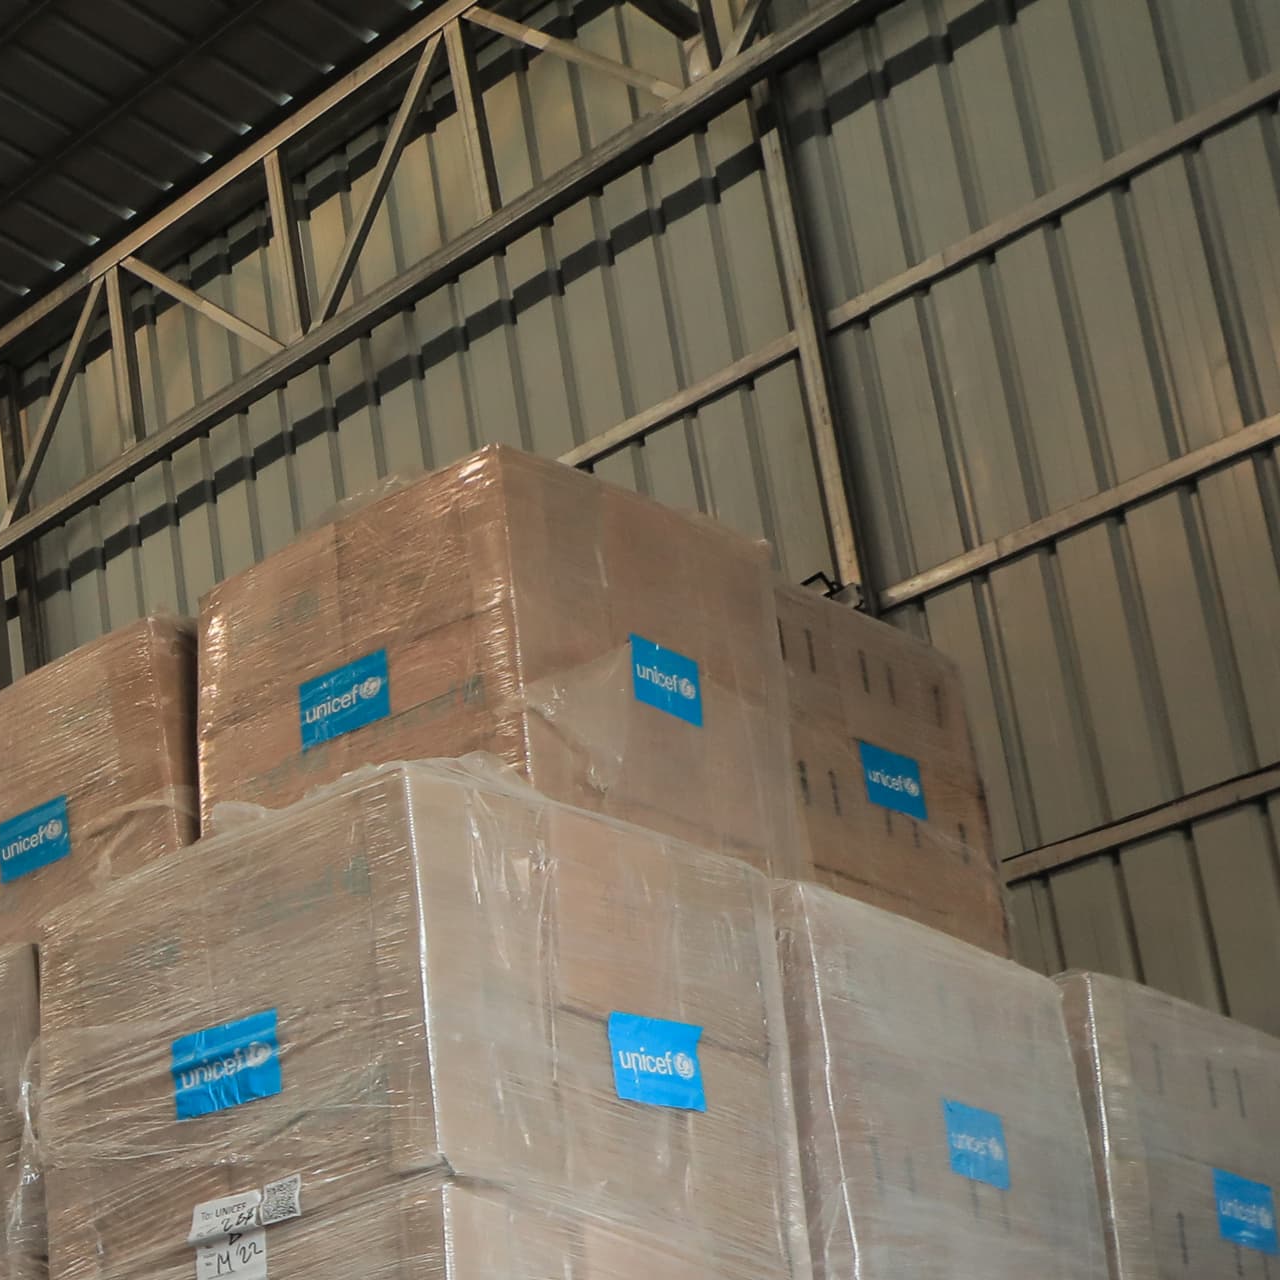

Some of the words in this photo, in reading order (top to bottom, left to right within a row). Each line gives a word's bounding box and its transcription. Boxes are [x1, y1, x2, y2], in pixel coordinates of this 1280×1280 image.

[636, 663, 679, 693] unicef
[305, 683, 360, 724] unicef
[1, 825, 48, 861] unicef
[181, 1047, 245, 1090] unicef
[618, 1046, 673, 1076] unicef
